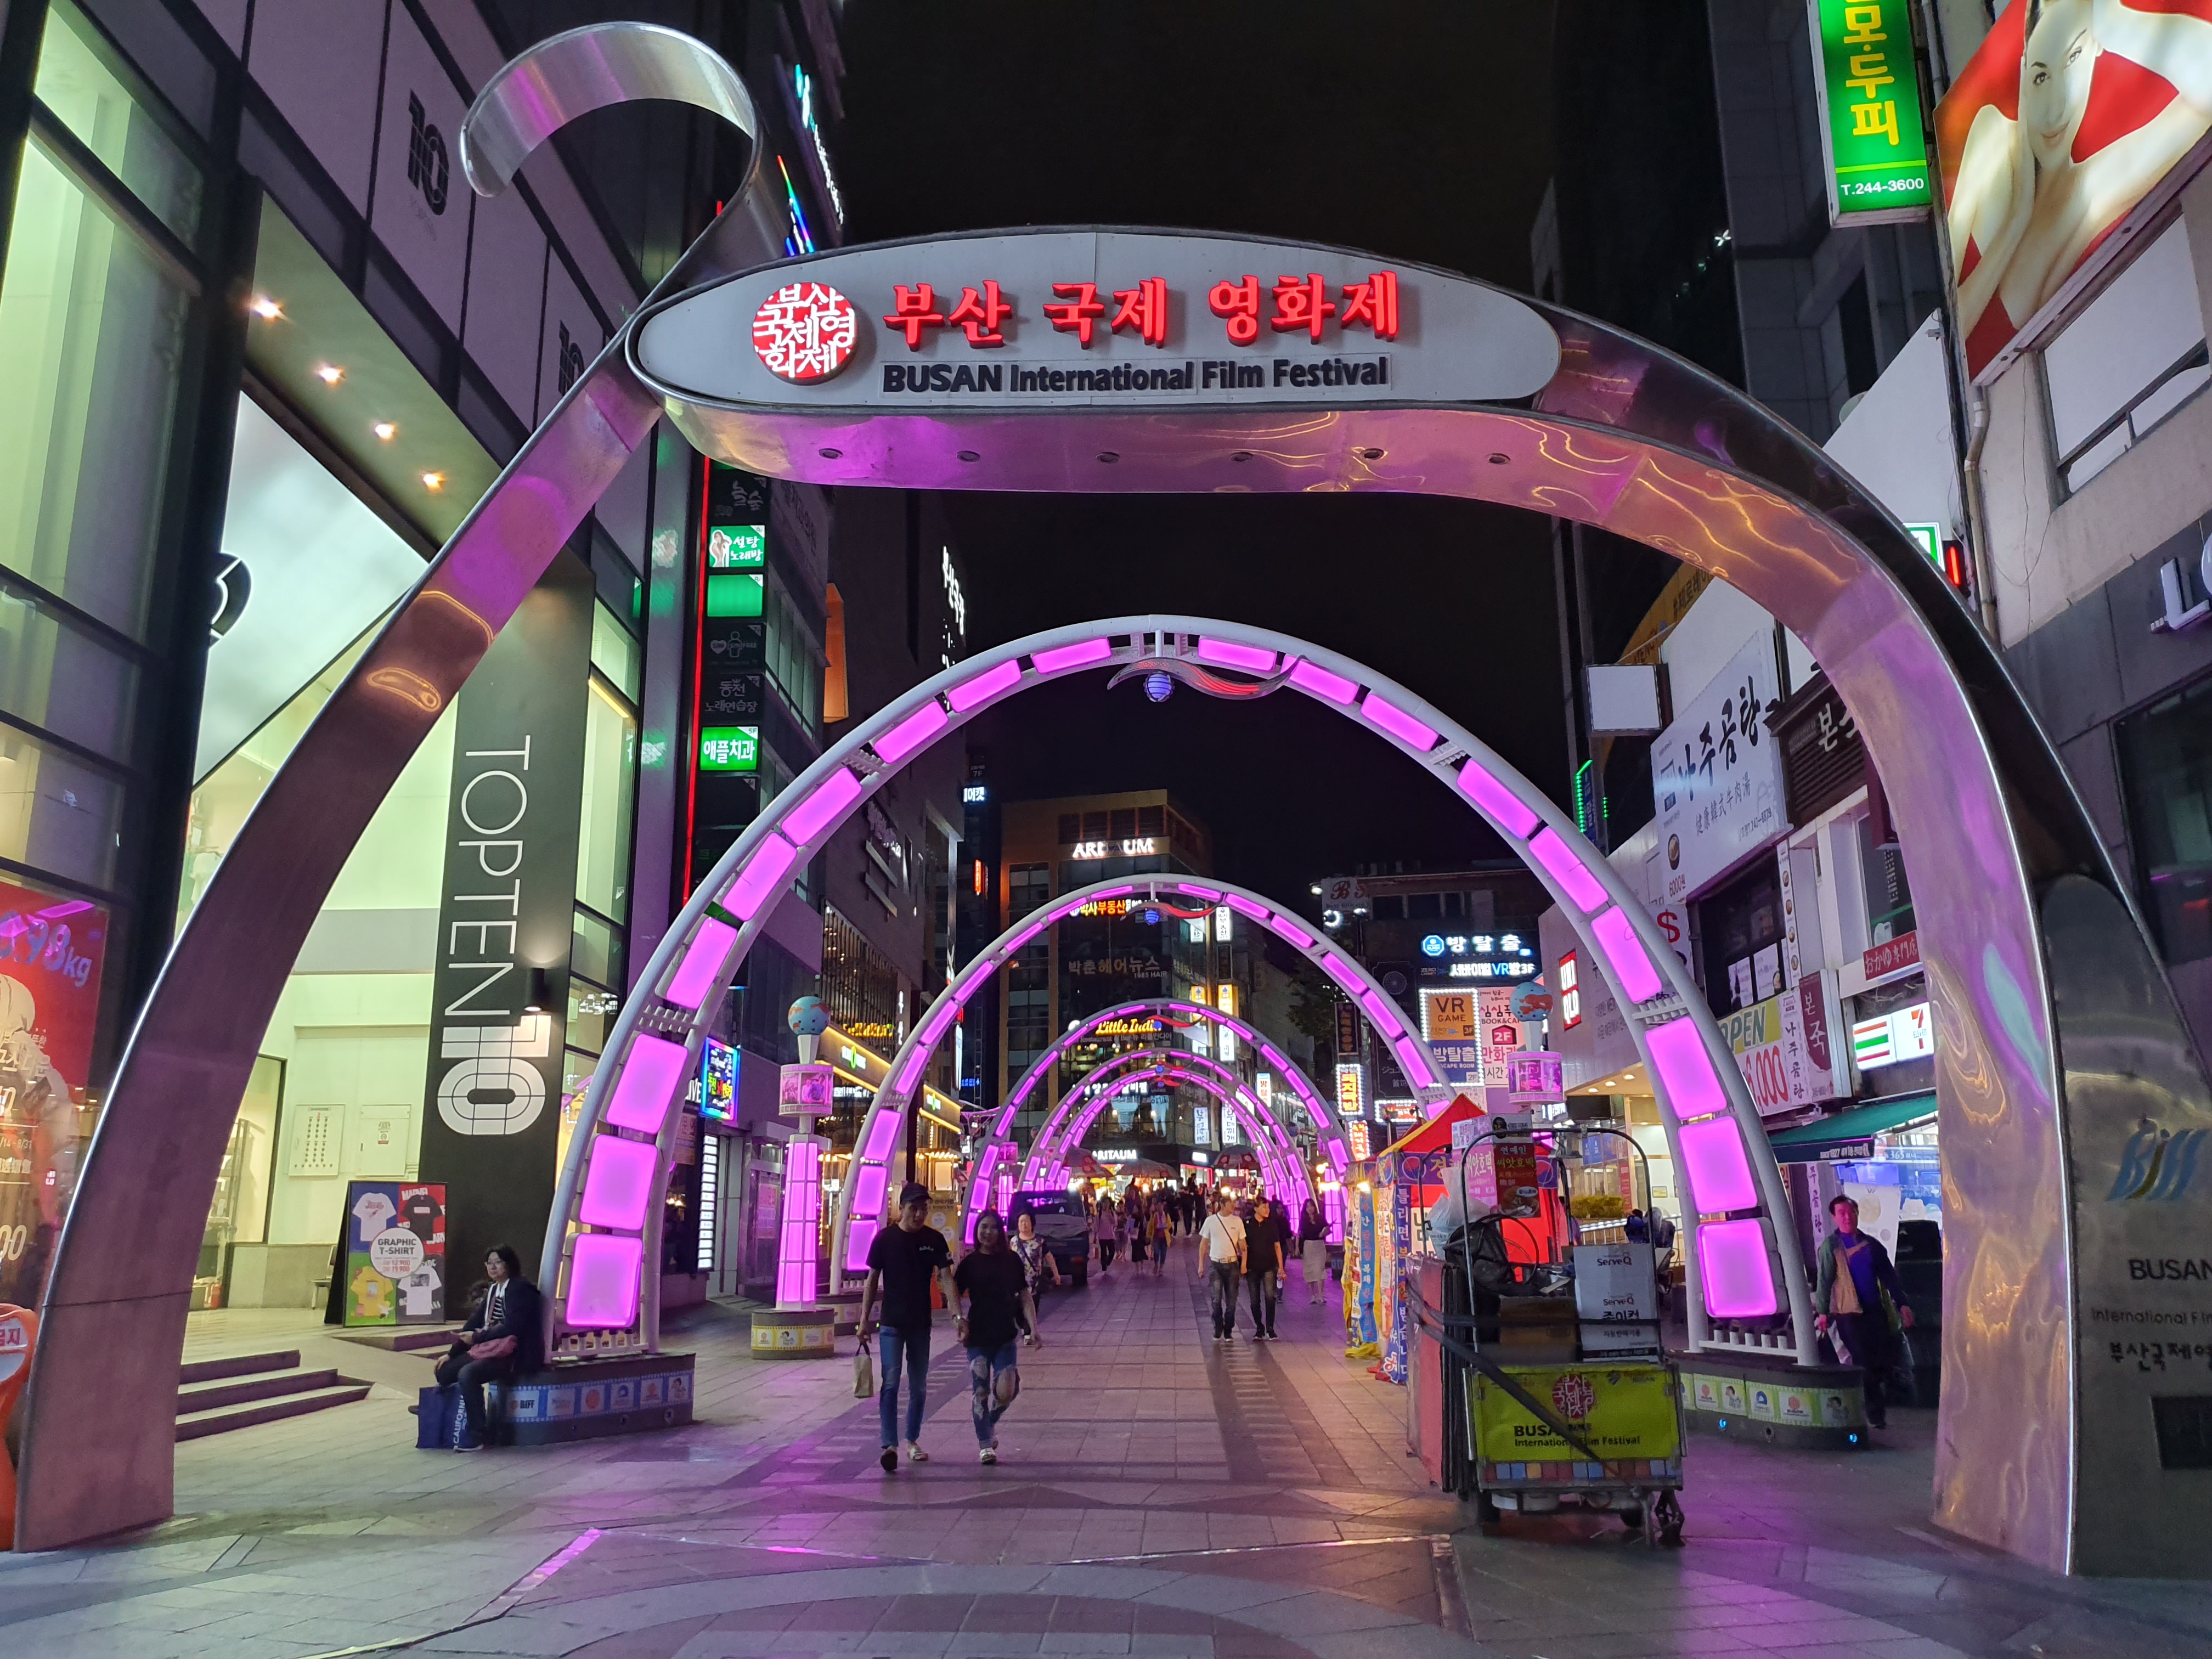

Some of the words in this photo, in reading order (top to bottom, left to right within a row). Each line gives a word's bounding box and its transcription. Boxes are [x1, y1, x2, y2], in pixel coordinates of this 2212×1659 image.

[1842, 0, 1900, 145] 모·두피
[1841, 178, 1925, 197] T.244-3600
[883, 280, 1012, 352] 부산
[1043, 277, 1166, 349] 국제
[1209, 270, 1399, 346] 영화제
[883, 364, 1002, 393] BUSAN
[1011, 361, 1194, 393] International
[1202, 360, 1262, 390] Film
[1273, 357, 1386, 387] Festival
[732, 535, 760, 549] 설탕
[730, 549, 764, 562] 노래방
[705, 699, 758, 713] 노래연습장
[703, 739, 755, 763] 애플치과
[444, 735, 531, 1015] TOPTEN
[1435, 997, 1465, 1013] VR
[1437, 1014, 1466, 1022] GAME
[1804, 992, 1826, 1056] 본죽
[1096, 1019, 1128, 1035] Little
[1128, 1018, 1163, 1033] Indi
[1494, 1031, 1512, 1042] 2F
[1433, 1046, 1476, 1063] 방탈출
[1785, 1022, 1805, 1099] 나주곰탕
[377, 1238, 417, 1246] GRAPHIC
[379, 1247, 415, 1255] T-SHIRT
[1514, 1425, 1551, 1436] BUS
[1514, 1437, 1569, 1447] Internation
